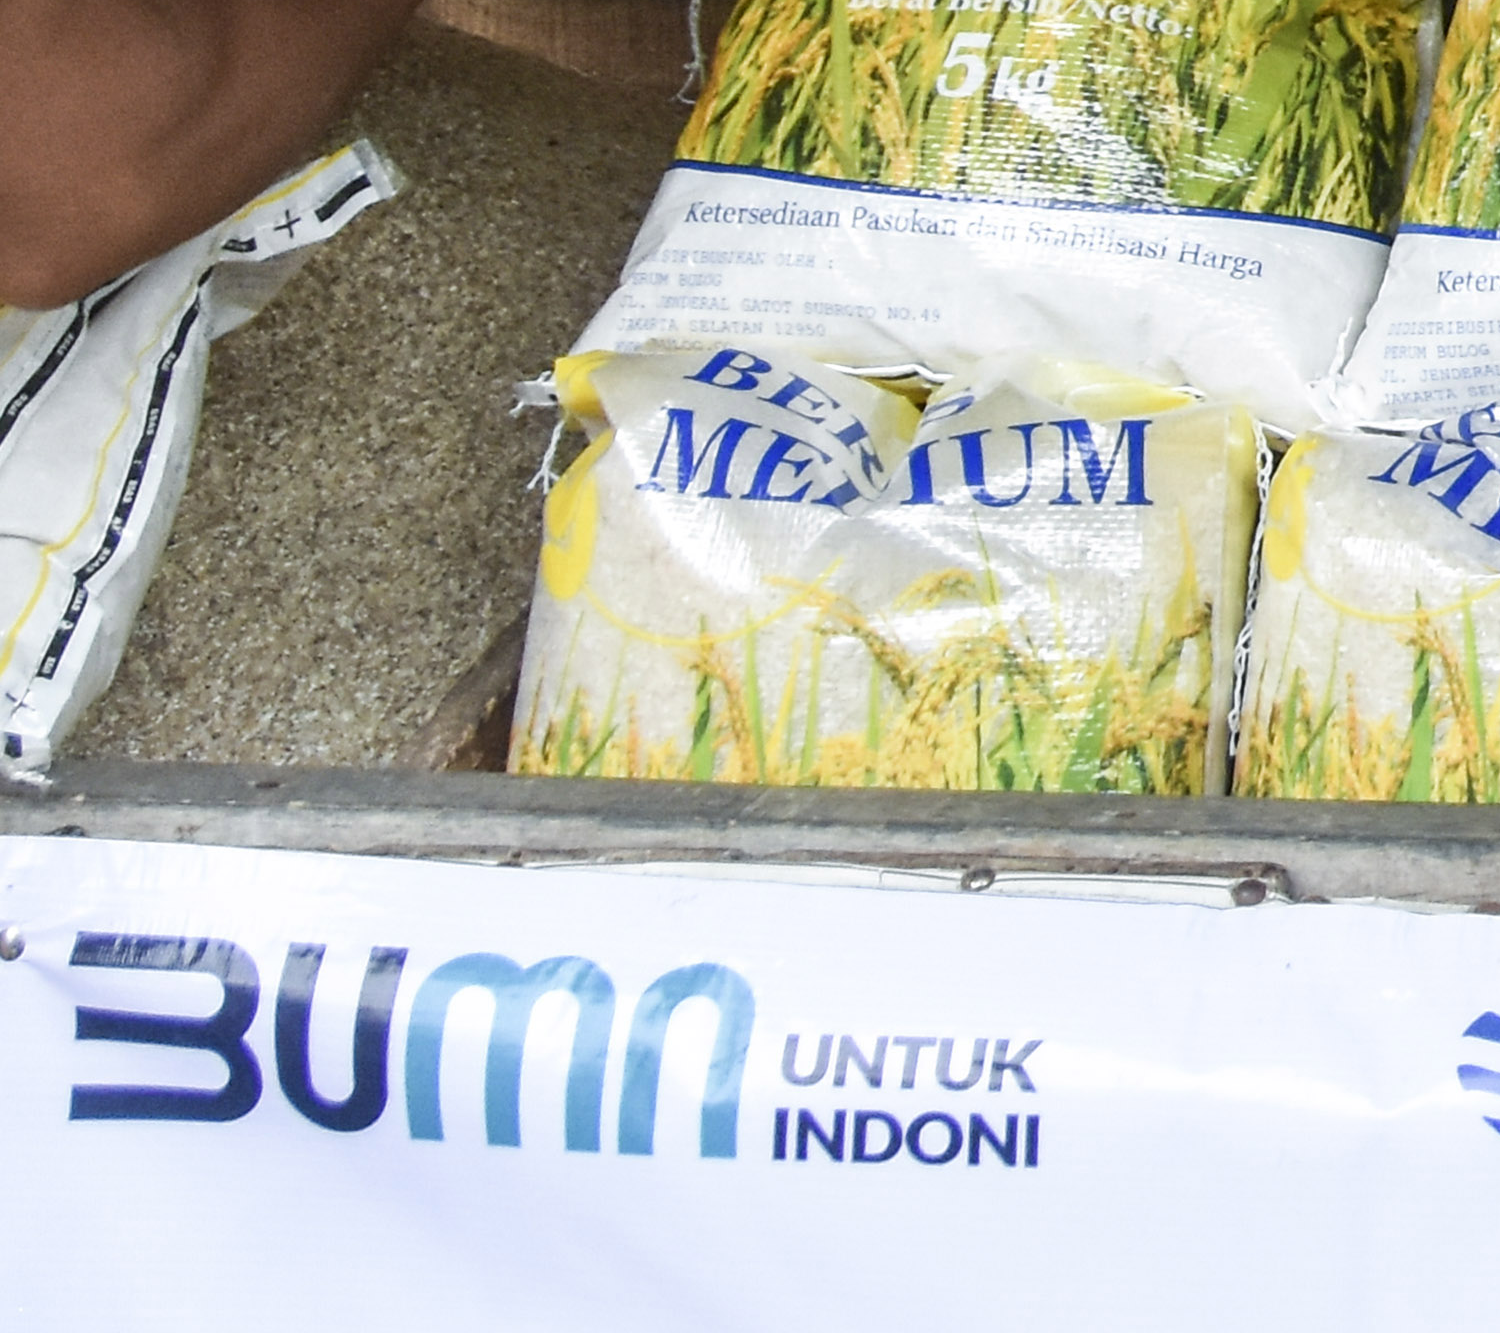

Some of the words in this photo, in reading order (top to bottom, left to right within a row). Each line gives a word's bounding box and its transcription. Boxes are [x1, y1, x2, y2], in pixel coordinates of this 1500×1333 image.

[936, 31, 994, 99] 5
[684, 201, 841, 231] Ketersediaan
[850, 206, 957, 237] Pasokan
[1178, 234, 1265, 280] Harga
[887, 305, 942, 323] NO.49
[1436, 343, 1490, 359] BULOG
[779, 1032, 1044, 1095] UNTUK
[770, 1109, 1043, 1168] INDONI
